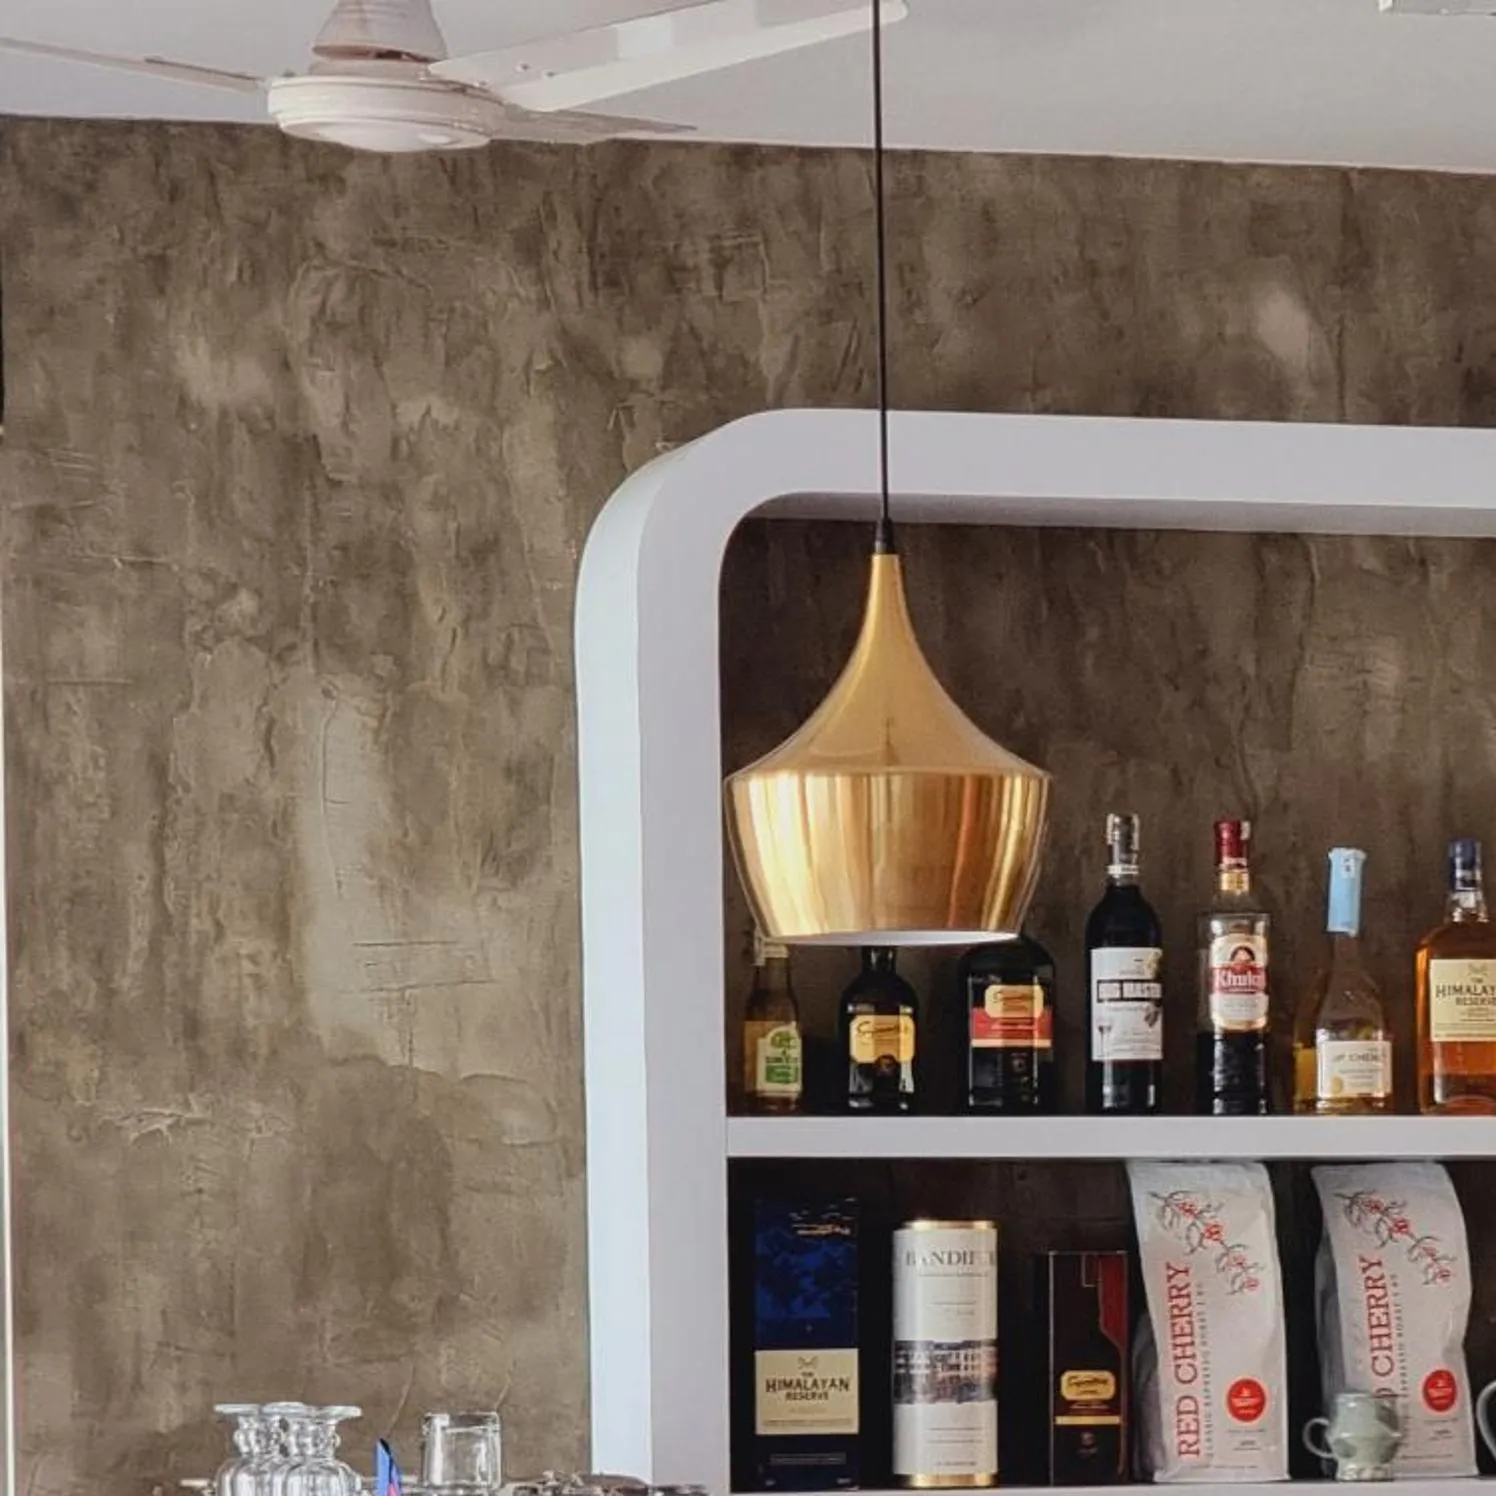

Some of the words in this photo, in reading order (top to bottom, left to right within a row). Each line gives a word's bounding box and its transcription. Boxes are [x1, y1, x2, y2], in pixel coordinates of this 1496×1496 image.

[1166, 1261, 1198, 1384] CHERRY
[1359, 1256, 1394, 1377] CHERRY
[765, 1378, 850, 1392] HIMALAYAN
[1175, 1395, 1200, 1456] RED
